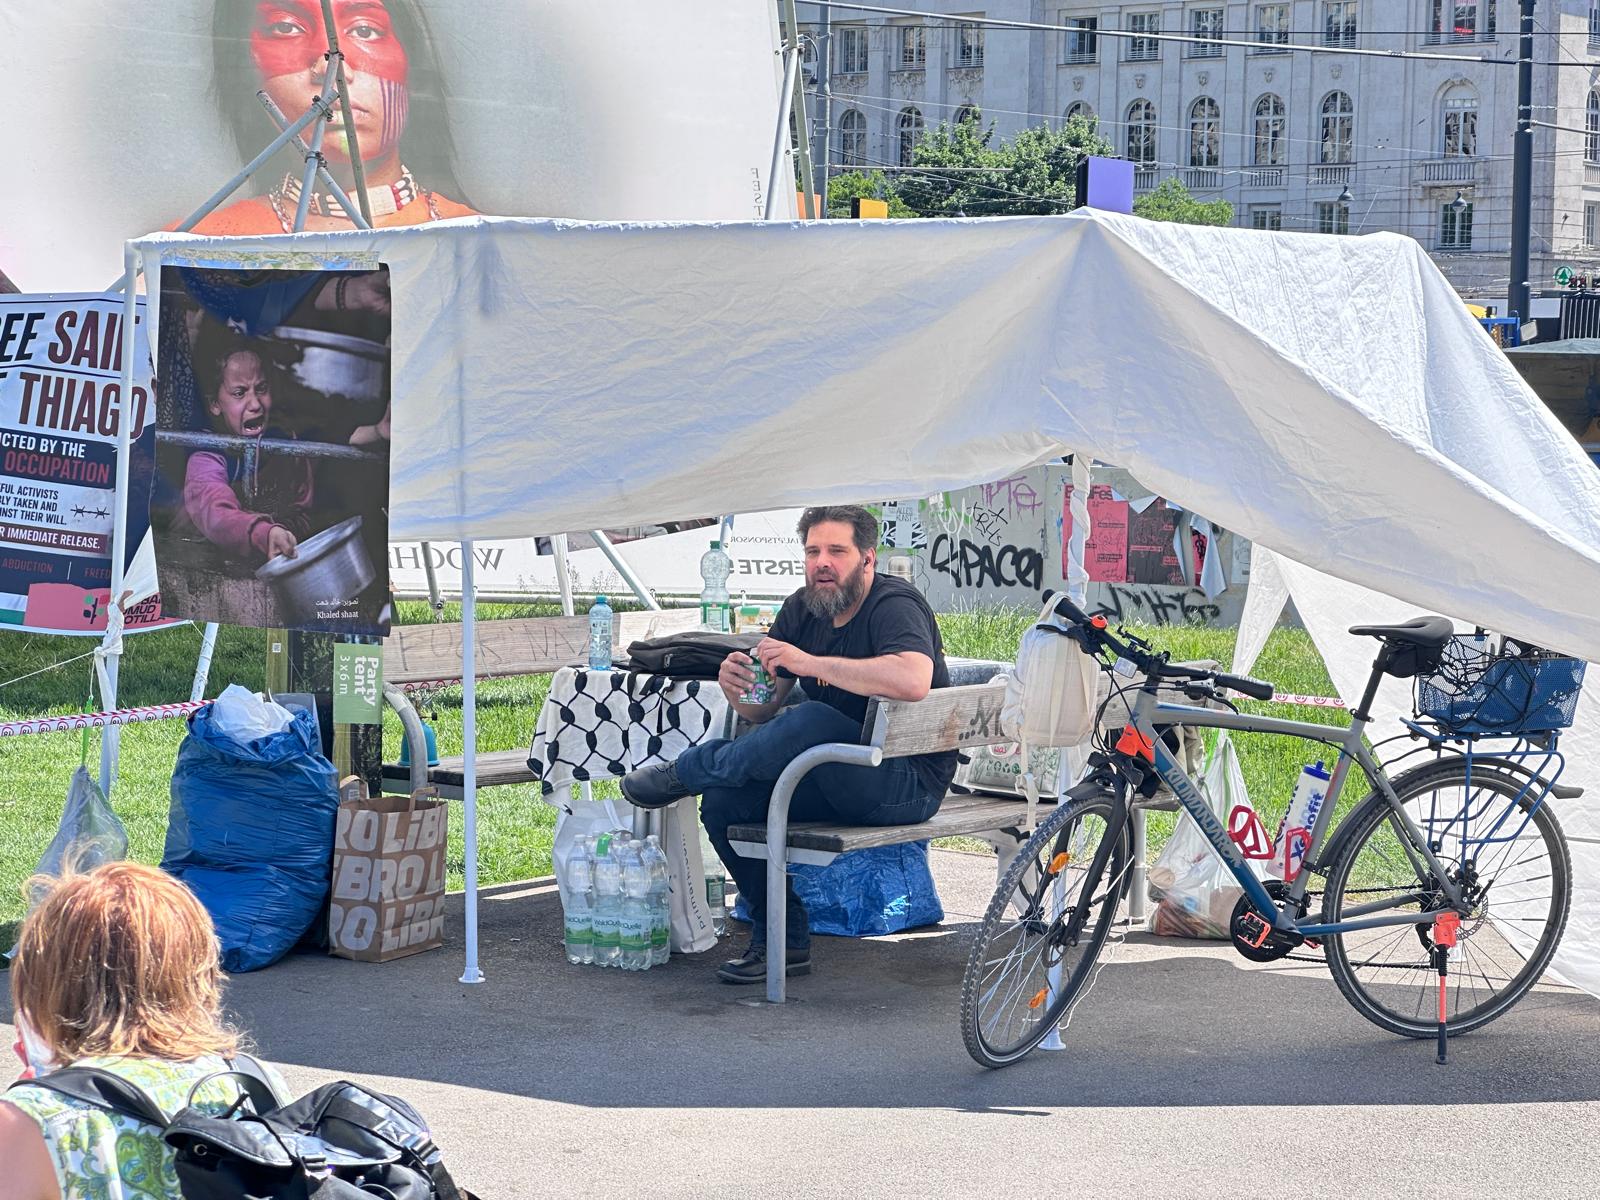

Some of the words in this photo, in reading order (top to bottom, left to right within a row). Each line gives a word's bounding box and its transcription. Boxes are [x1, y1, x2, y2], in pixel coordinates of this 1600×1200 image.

[0, 312, 46, 362] EE
[19, 371, 148, 440] THIAGO
[0, 432, 37, 451] CTED
[39, 438, 58, 454] BY
[61, 441, 87, 458] THE
[4, 450, 111, 484] OCCUPATION
[0, 483, 15, 495] FUL
[17, 485, 59, 500] ACTIVISTS
[13, 497, 39, 510] TAKEN
[40, 501, 58, 512] AND
[20, 510, 44, 523] THEIR
[46, 513, 67, 526] WILL.
[7, 527, 59, 545] IMMEDIATE
[60, 534, 101, 549] RELEASE.
[2, 558, 54, 574] ABDUCTION
[317, 610, 340, 619] Khaled
[341, 610, 359, 618] shaat
[354, 655, 367, 695] tent
[363, 657, 380, 707] Party
